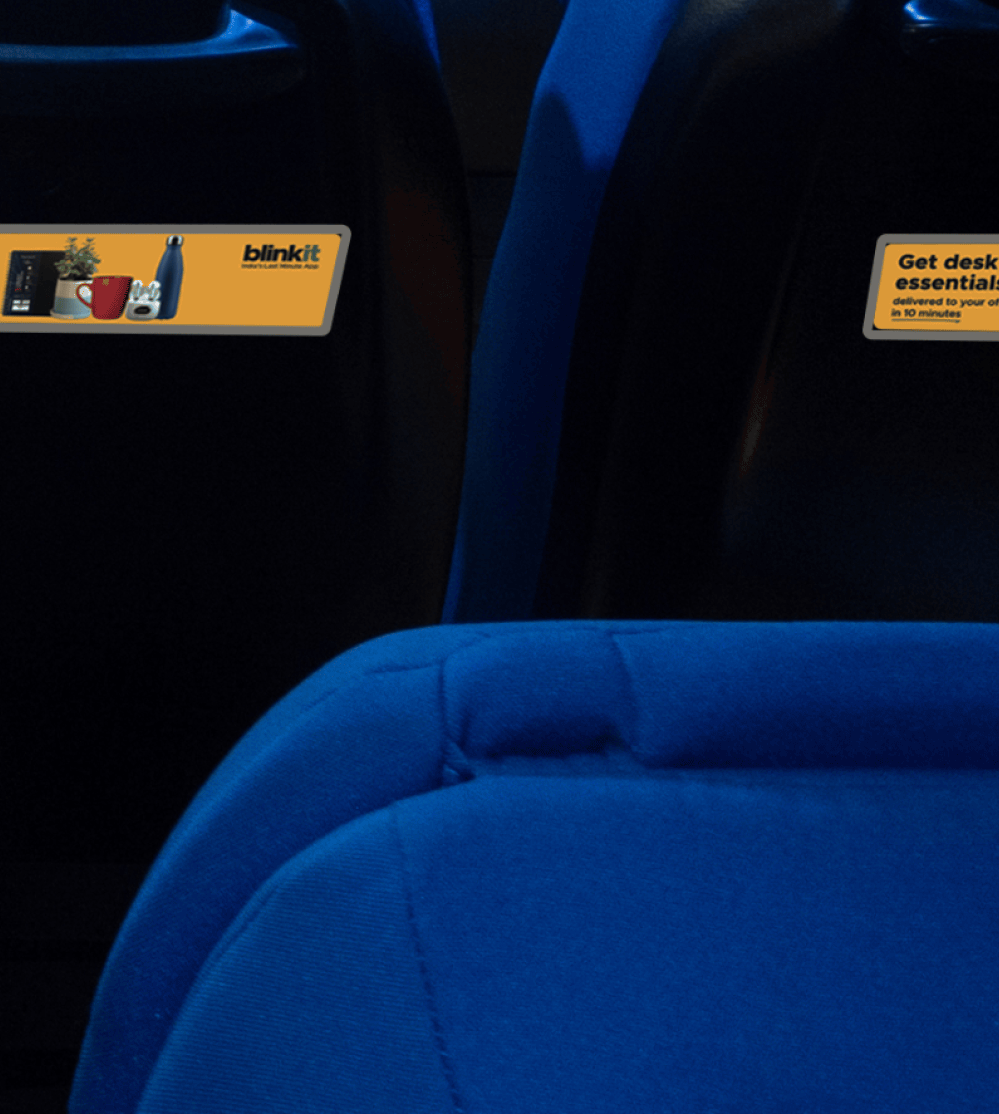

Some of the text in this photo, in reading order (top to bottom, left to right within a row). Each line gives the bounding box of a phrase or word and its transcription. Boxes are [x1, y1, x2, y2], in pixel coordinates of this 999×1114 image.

[243, 244, 321, 261] blinkit
[898, 254, 999, 270] Get desk
[895, 273, 999, 290] essential
[892, 297, 943, 306] delivered
[946, 298, 958, 306] to
[959, 299, 985, 308] your
[891, 308, 961, 318] in 10 minutes
